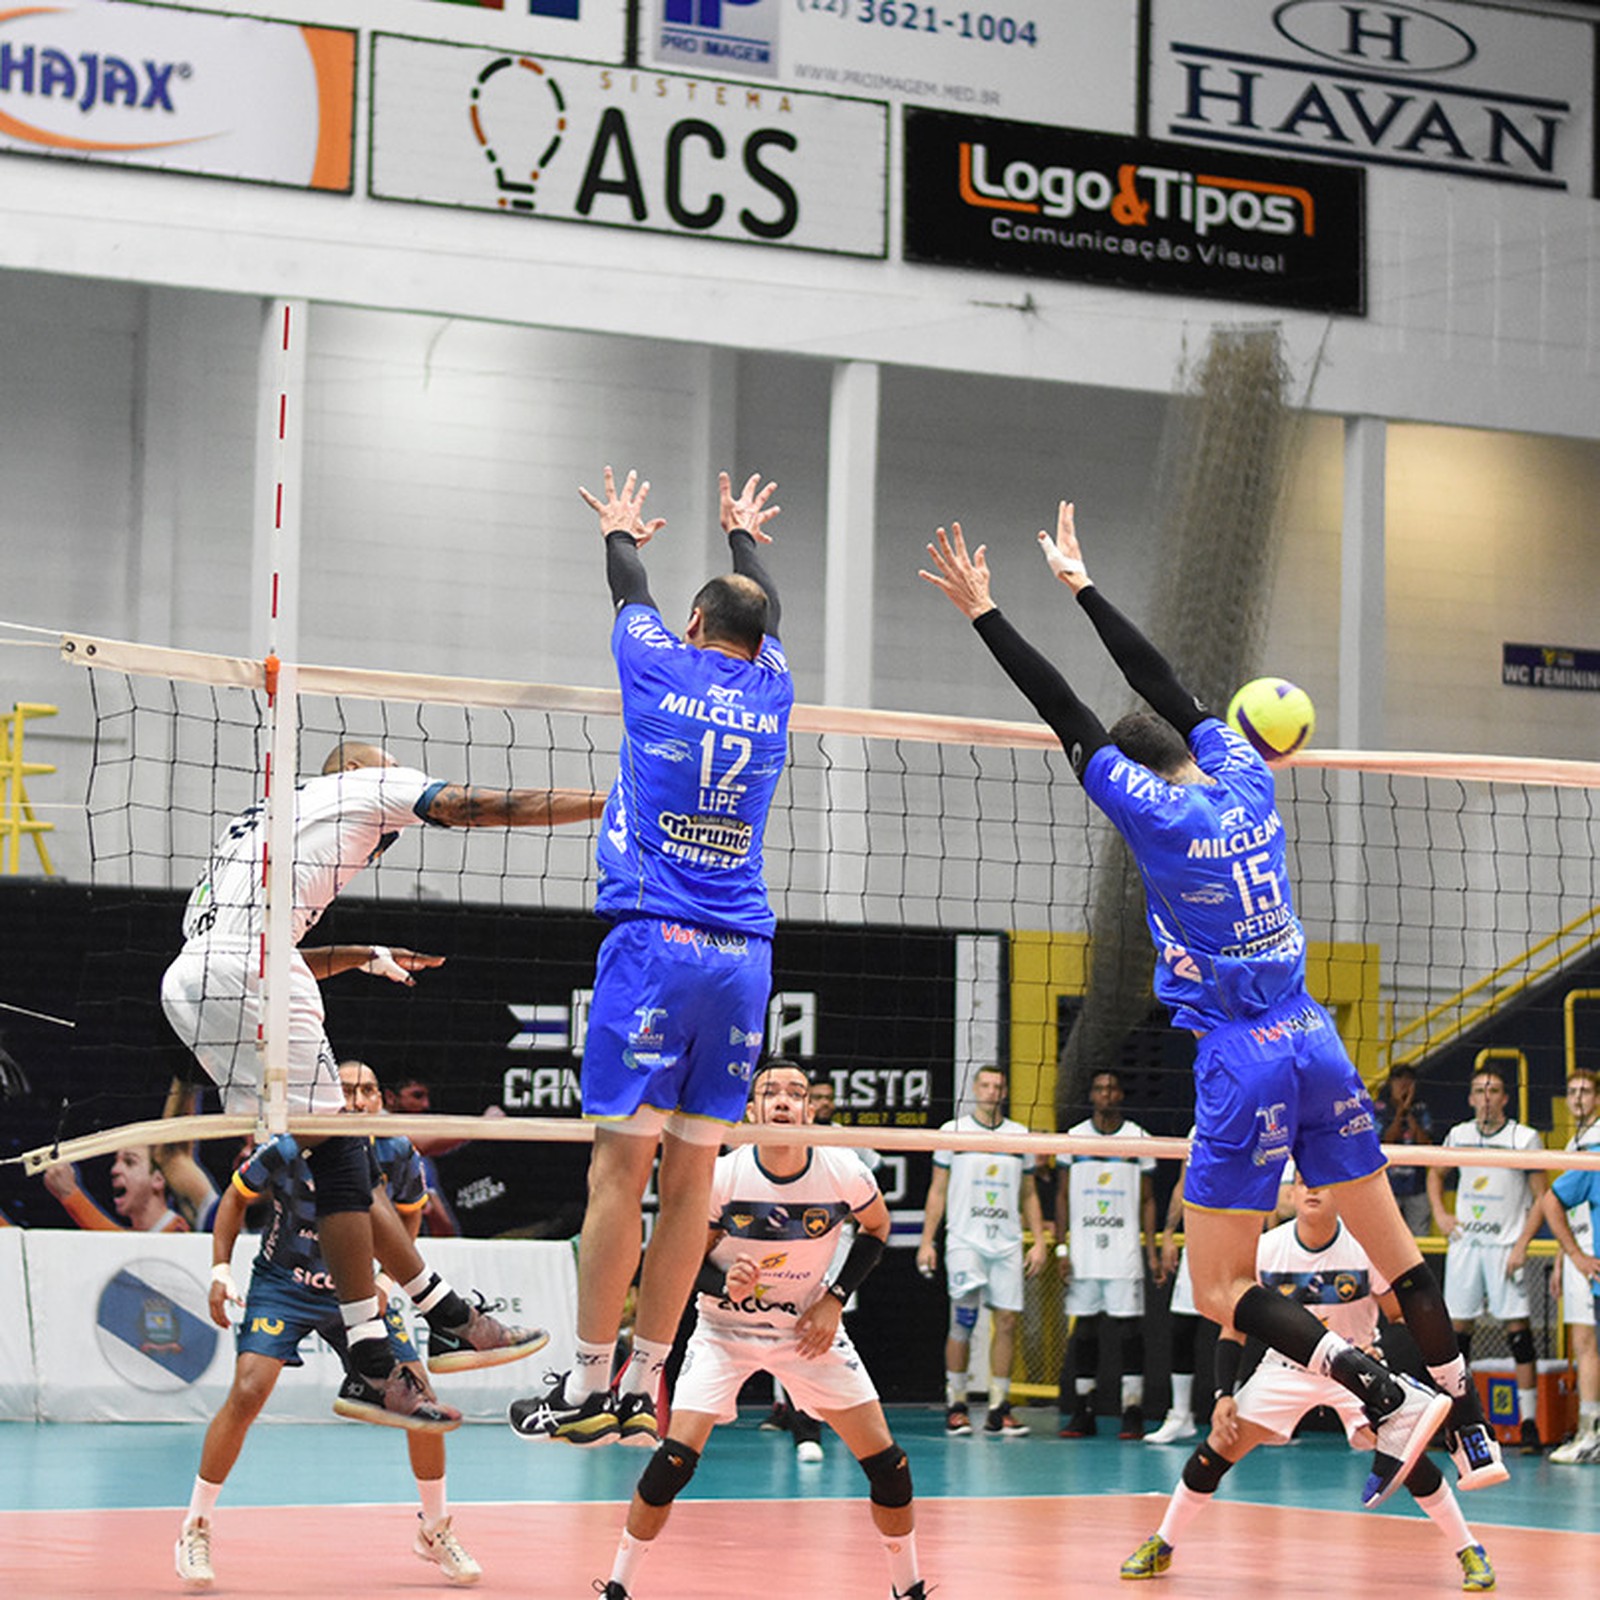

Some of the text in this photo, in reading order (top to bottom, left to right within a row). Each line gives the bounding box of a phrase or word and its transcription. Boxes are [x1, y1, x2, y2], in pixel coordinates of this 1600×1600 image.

[660, 33, 699, 54] PRO
[1341, 5, 1411, 64] H
[600, 70, 793, 113] SISTEMA
[1174, 59, 1562, 173] HAVAN
[574, 106, 799, 240] ACS
[990, 216, 1287, 274] Comunicação Visual
[1504, 663, 1600, 689] WC FEMININ
[658, 691, 779, 735] MILCLEAN
[699, 728, 753, 793] 12
[697, 789, 742, 816] LIPE
[1187, 808, 1282, 858] MILCLEAN
[1232, 851, 1283, 917] 15
